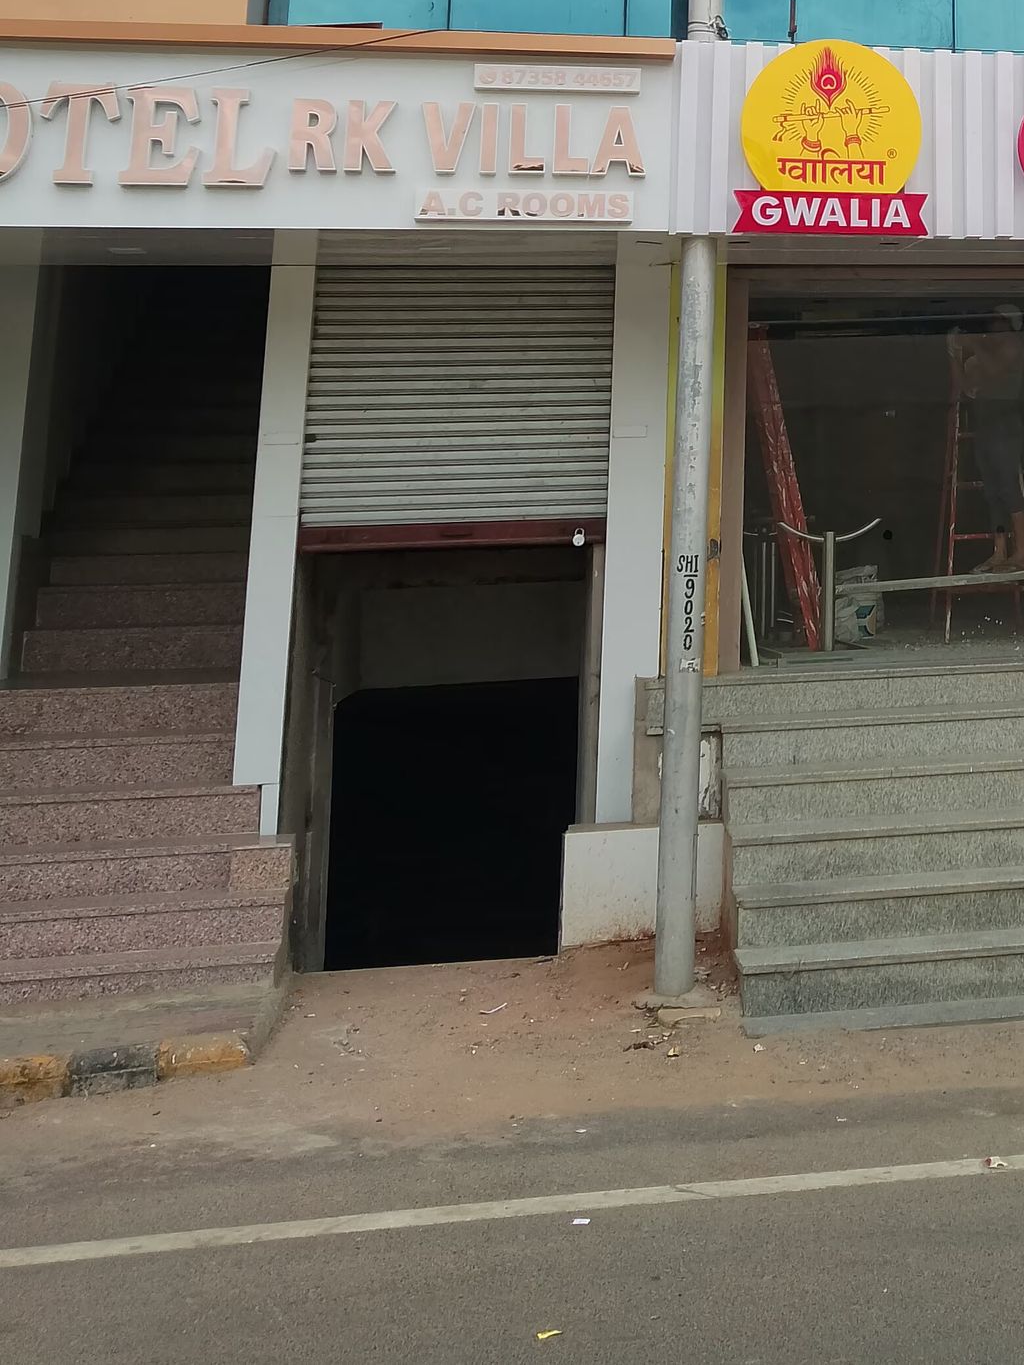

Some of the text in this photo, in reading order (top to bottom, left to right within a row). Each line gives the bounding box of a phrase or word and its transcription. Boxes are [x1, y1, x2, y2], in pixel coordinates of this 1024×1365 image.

[287, 98, 398, 175] RK
[421, 101, 646, 178] VILLA
[776, 148, 886, 185] ग्वालिया
[418, 191, 630, 218] A.C ROOMS
[751, 195, 911, 228] GWALIA
[677, 554, 699, 573] SHI
[683, 578, 696, 651] 9020
